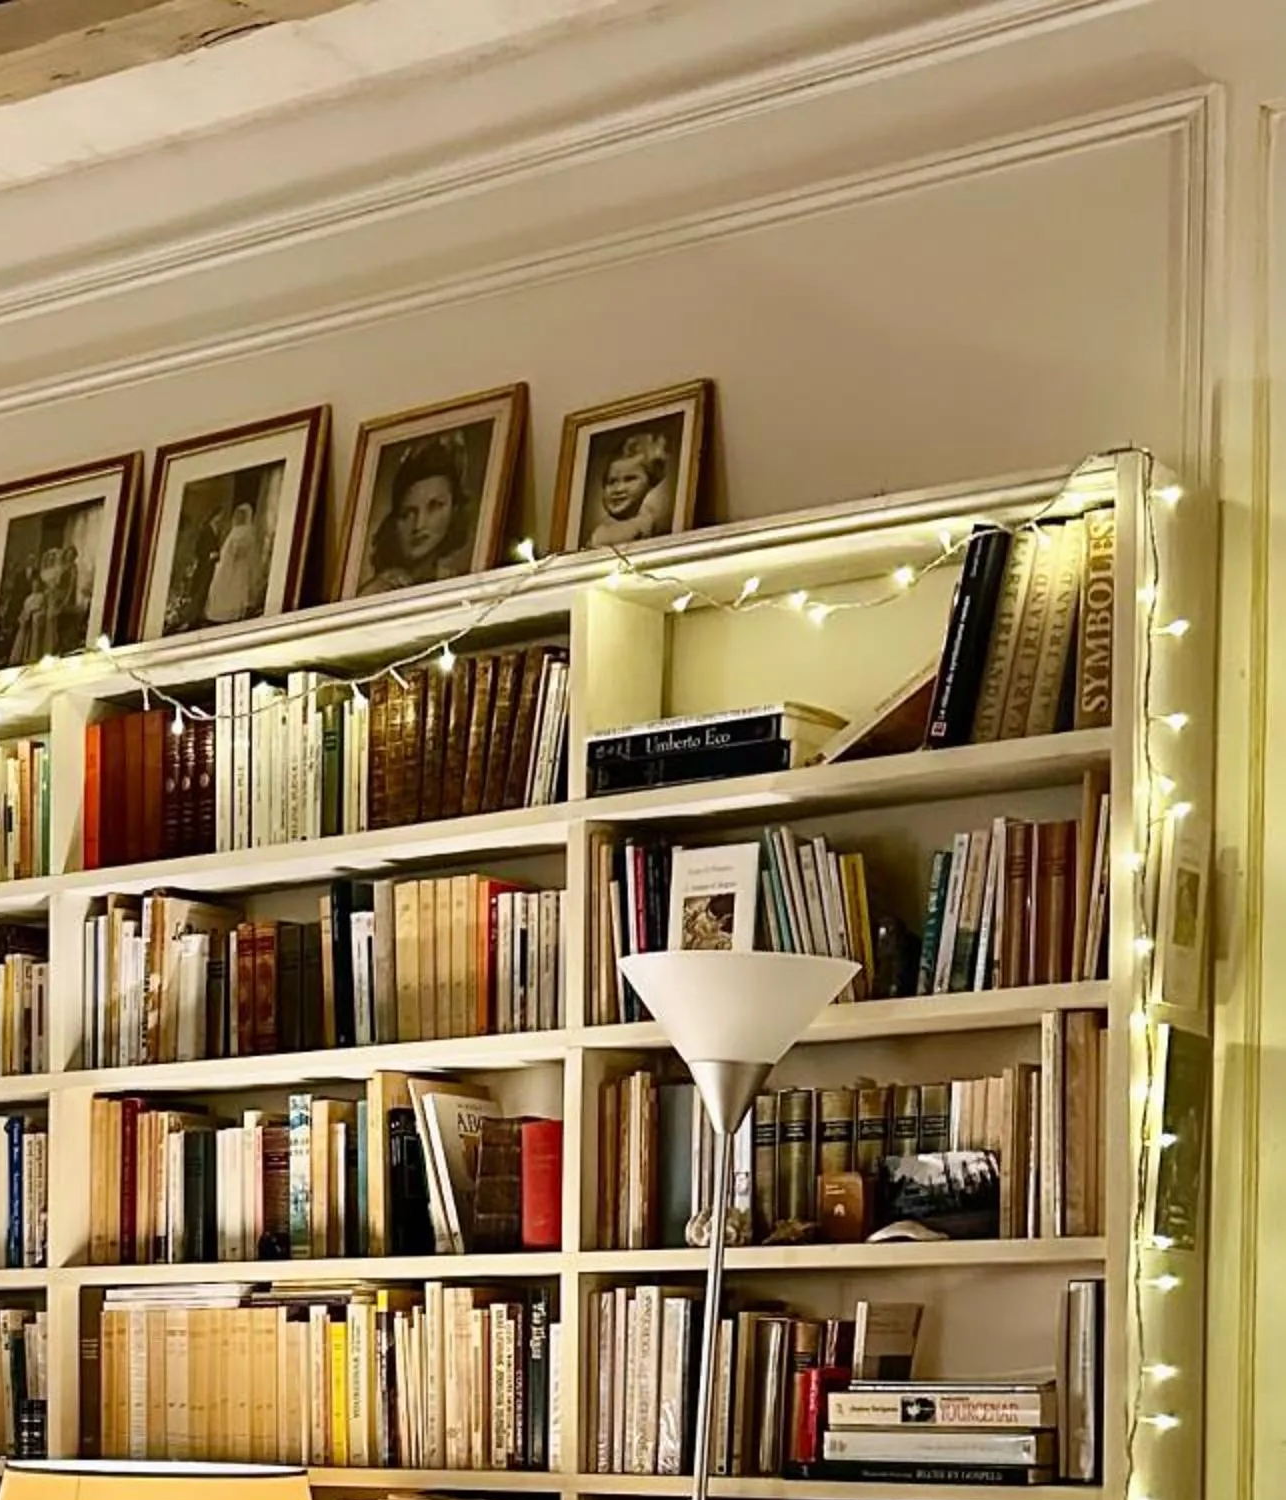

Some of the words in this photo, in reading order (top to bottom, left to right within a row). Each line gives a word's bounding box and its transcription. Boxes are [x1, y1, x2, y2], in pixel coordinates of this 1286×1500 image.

[1082, 518, 1115, 713] SYMBOLES
[645, 731, 701, 754] Umberto
[705, 728, 731, 746] Eco
